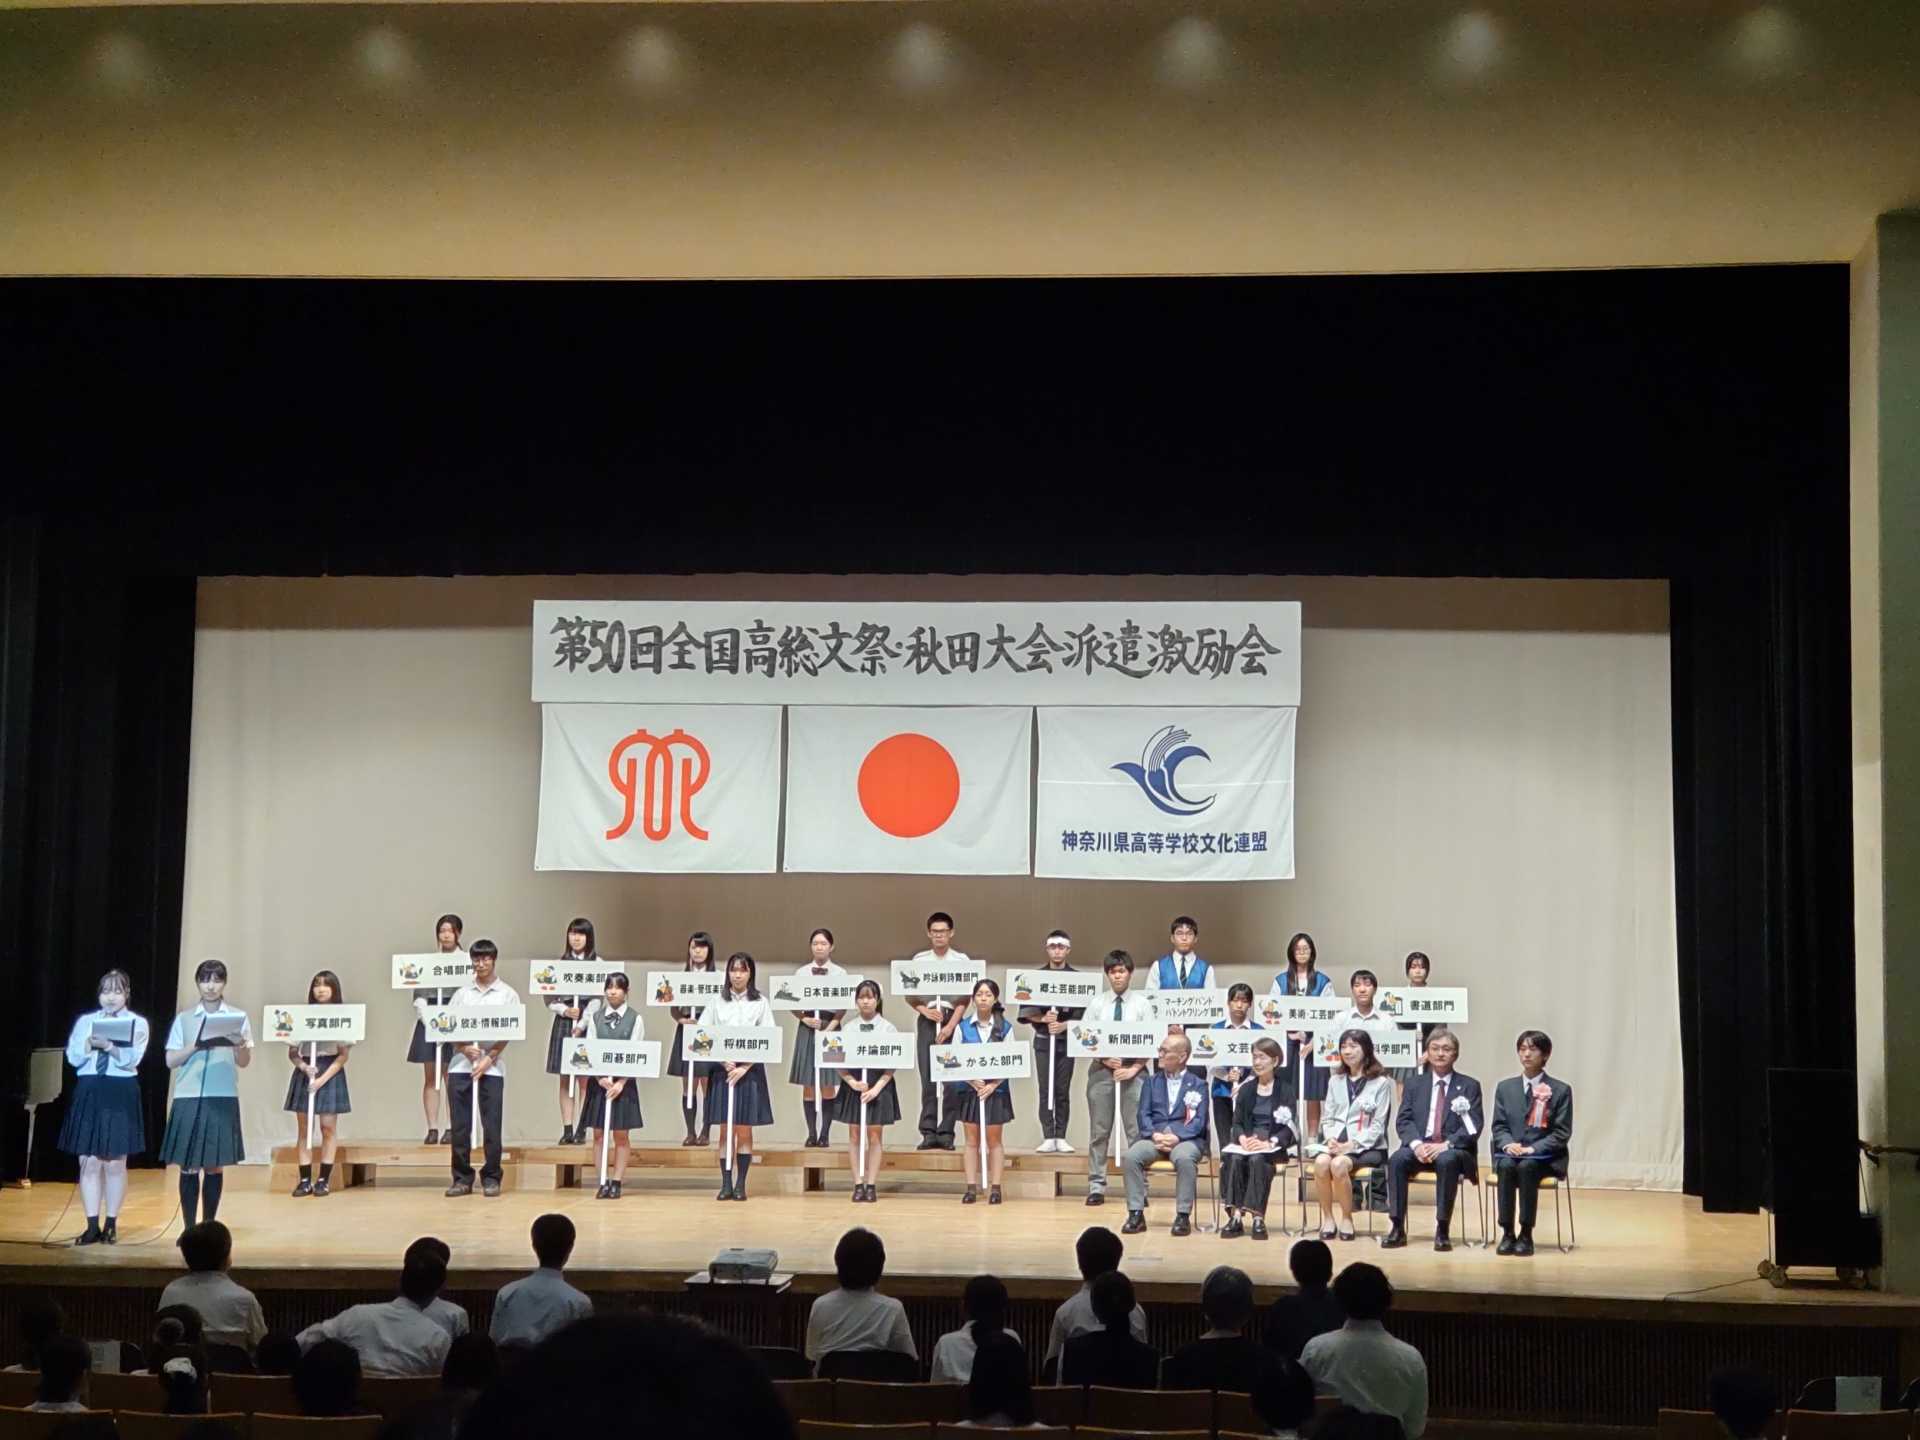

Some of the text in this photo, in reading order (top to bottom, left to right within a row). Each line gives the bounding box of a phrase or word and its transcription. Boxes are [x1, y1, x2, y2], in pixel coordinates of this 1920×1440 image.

[1061, 830, 1268, 854] 神奈川県高等学校文化連盟
[1040, 983, 1096, 996] 郷土芸能部門
[1410, 1000, 1455, 1012] 書道部門
[1288, 1008, 1344, 1020] 美術・工芸部
[305, 1017, 352, 1029] 写真部門
[724, 1039, 769, 1050] 将棋部門
[1108, 1034, 1154, 1046] 新聞部門
[856, 1045, 902, 1056] 弁論部門
[602, 1052, 647, 1065] 囲碁部門
[966, 1054, 1023, 1068] かるた部門
